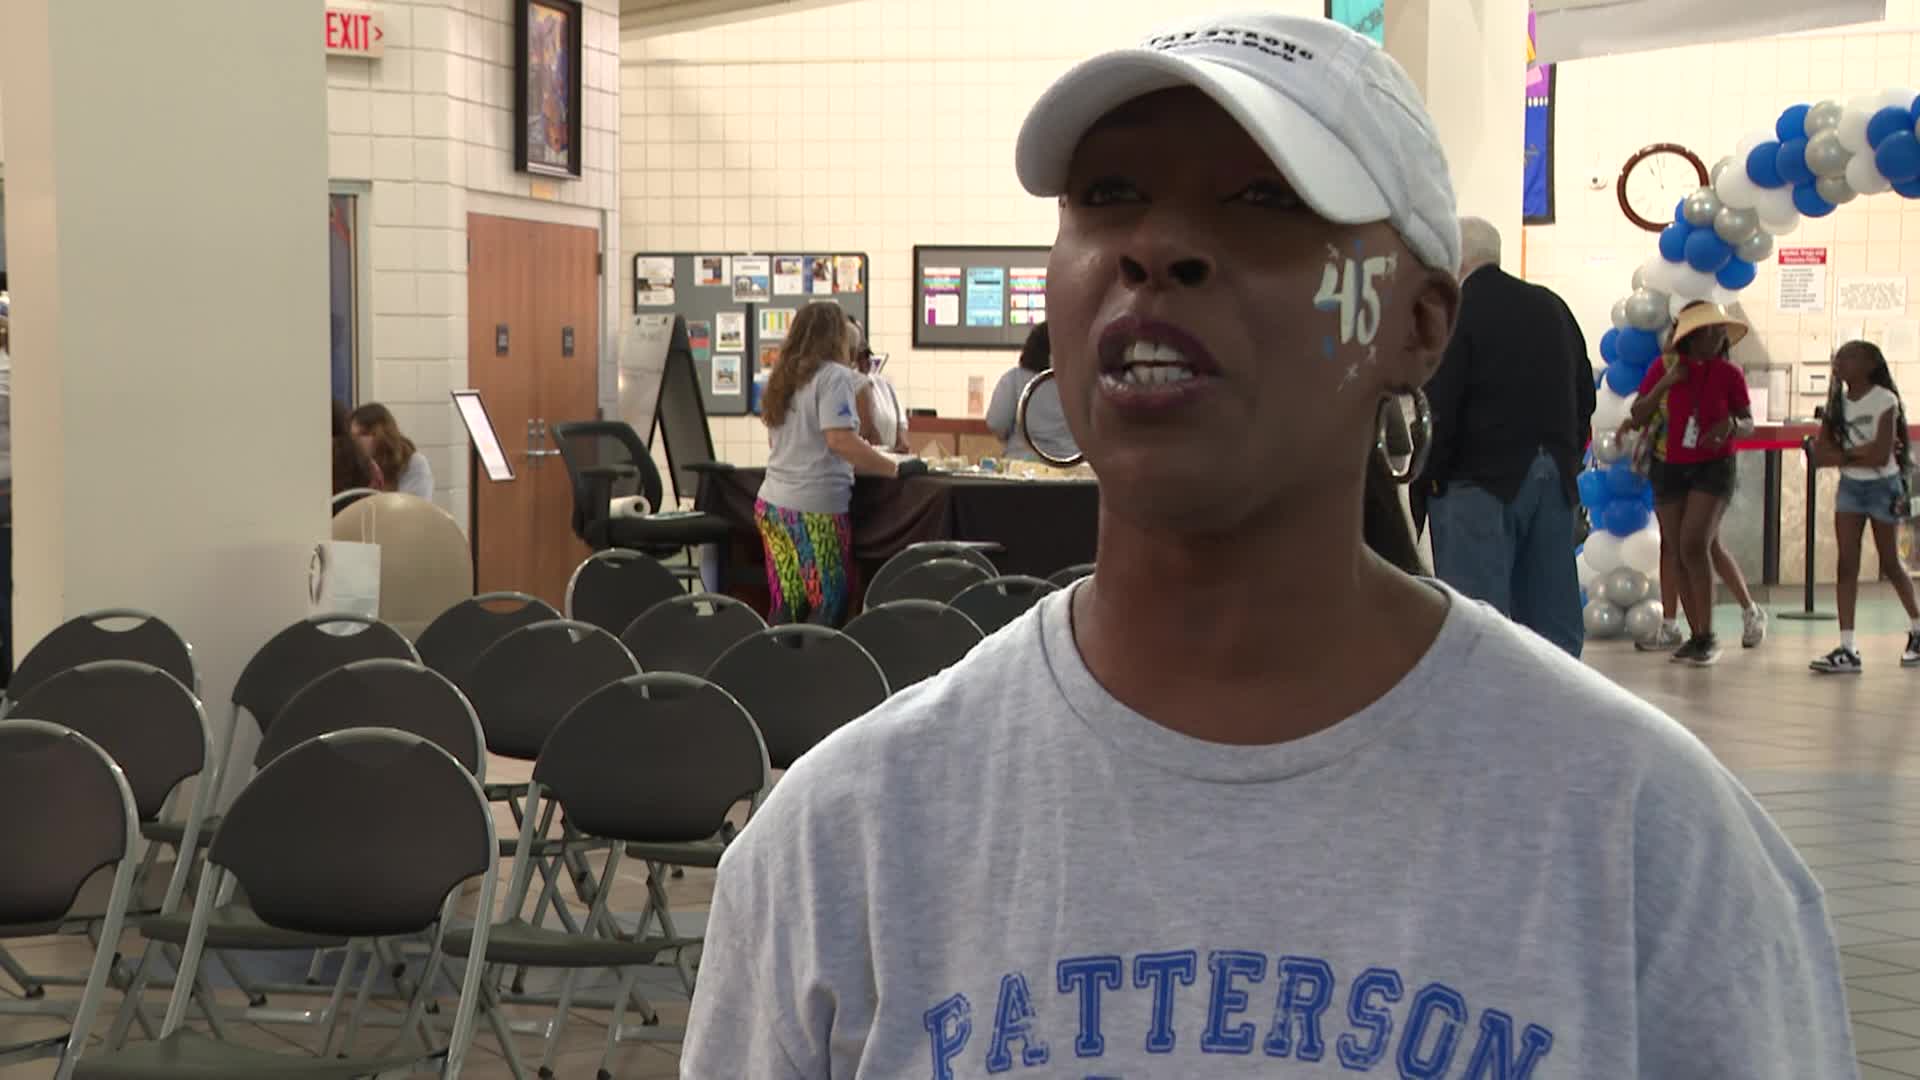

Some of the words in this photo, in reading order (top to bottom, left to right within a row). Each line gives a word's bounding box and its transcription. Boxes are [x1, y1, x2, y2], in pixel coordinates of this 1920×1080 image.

[325, 11, 371, 51] EXIT
[1206, 28, 1314, 61] STRONG
[1313, 256, 1382, 345] 45
[924, 949, 1553, 1080] PATTERSON
